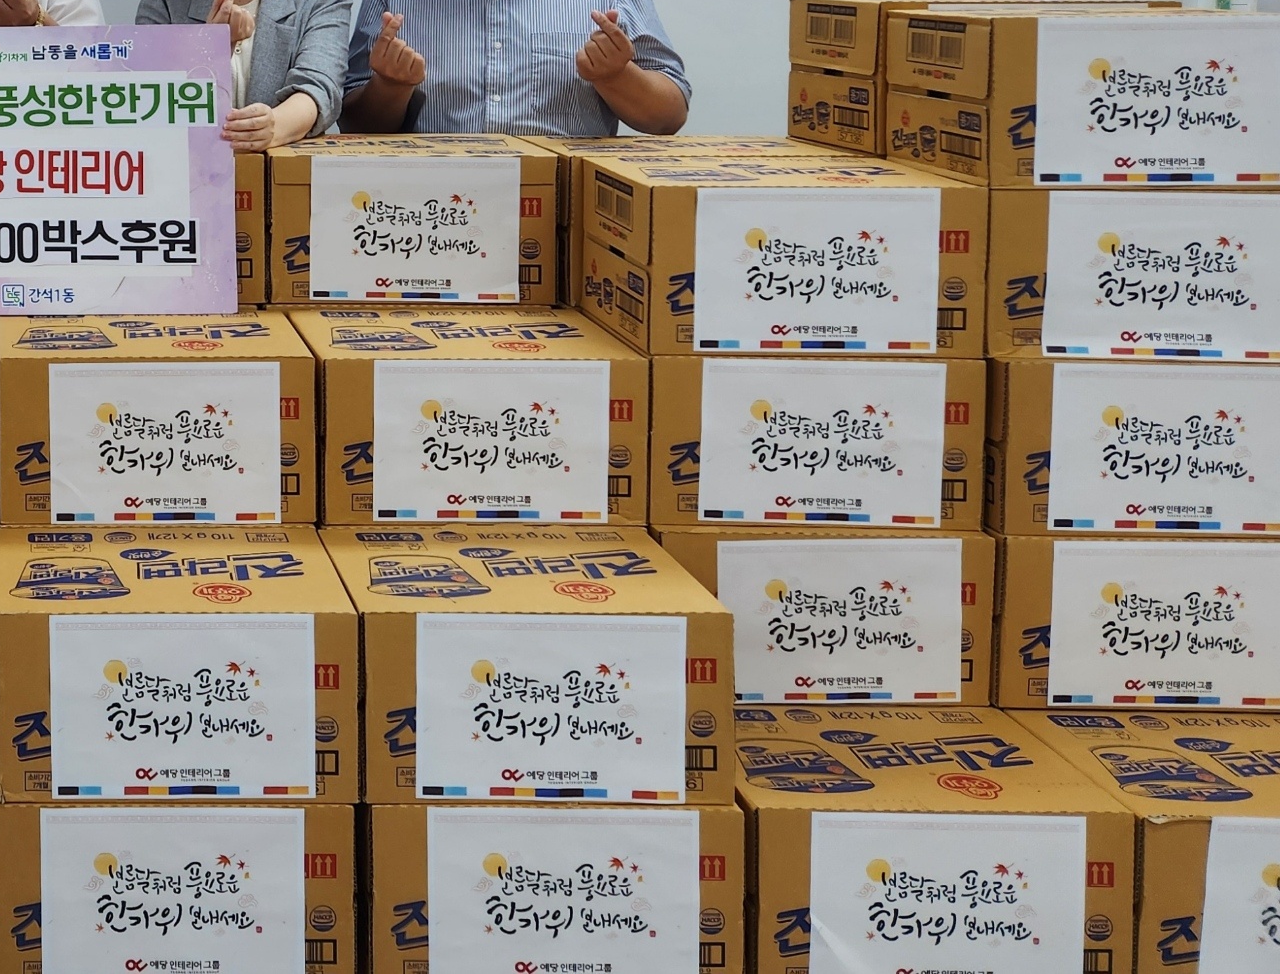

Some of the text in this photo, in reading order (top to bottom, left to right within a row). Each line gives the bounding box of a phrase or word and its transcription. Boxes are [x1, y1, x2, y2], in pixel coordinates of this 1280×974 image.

[31, 43, 128, 61] 남동을 새롭게
[1101, 66, 1227, 101] 보름달처럼 풍요로운
[1087, 98, 1240, 135] 한가위 보내세요
[15, 149, 144, 195] 인테리어
[363, 199, 468, 230] 보름달처럼 풍요로운
[352, 226, 480, 259] 한가위 보내세요
[758, 236, 879, 271] 보름달처럼 풍요로운
[28, 288, 75, 304] 간석1동
[745, 267, 891, 303] 한가위 보내세요
[433, 407, 550, 442] 보름달처럼 풍요로운
[1114, 415, 1235, 451] 보름달처럼 풍요로운
[421, 437, 563, 473] 한가위 보내세요
[1101, 445, 1247, 483] 한가위 보내세요
[778, 586, 901, 621] 보름달처럼 풍요로운
[766, 618, 915, 655] 한가위 보내세요
[118, 668, 250, 707] 보름달처럼 풍요로운
[105, 703, 265, 744] 한가위 보내세요
[160, 768, 177, 778] 예당
